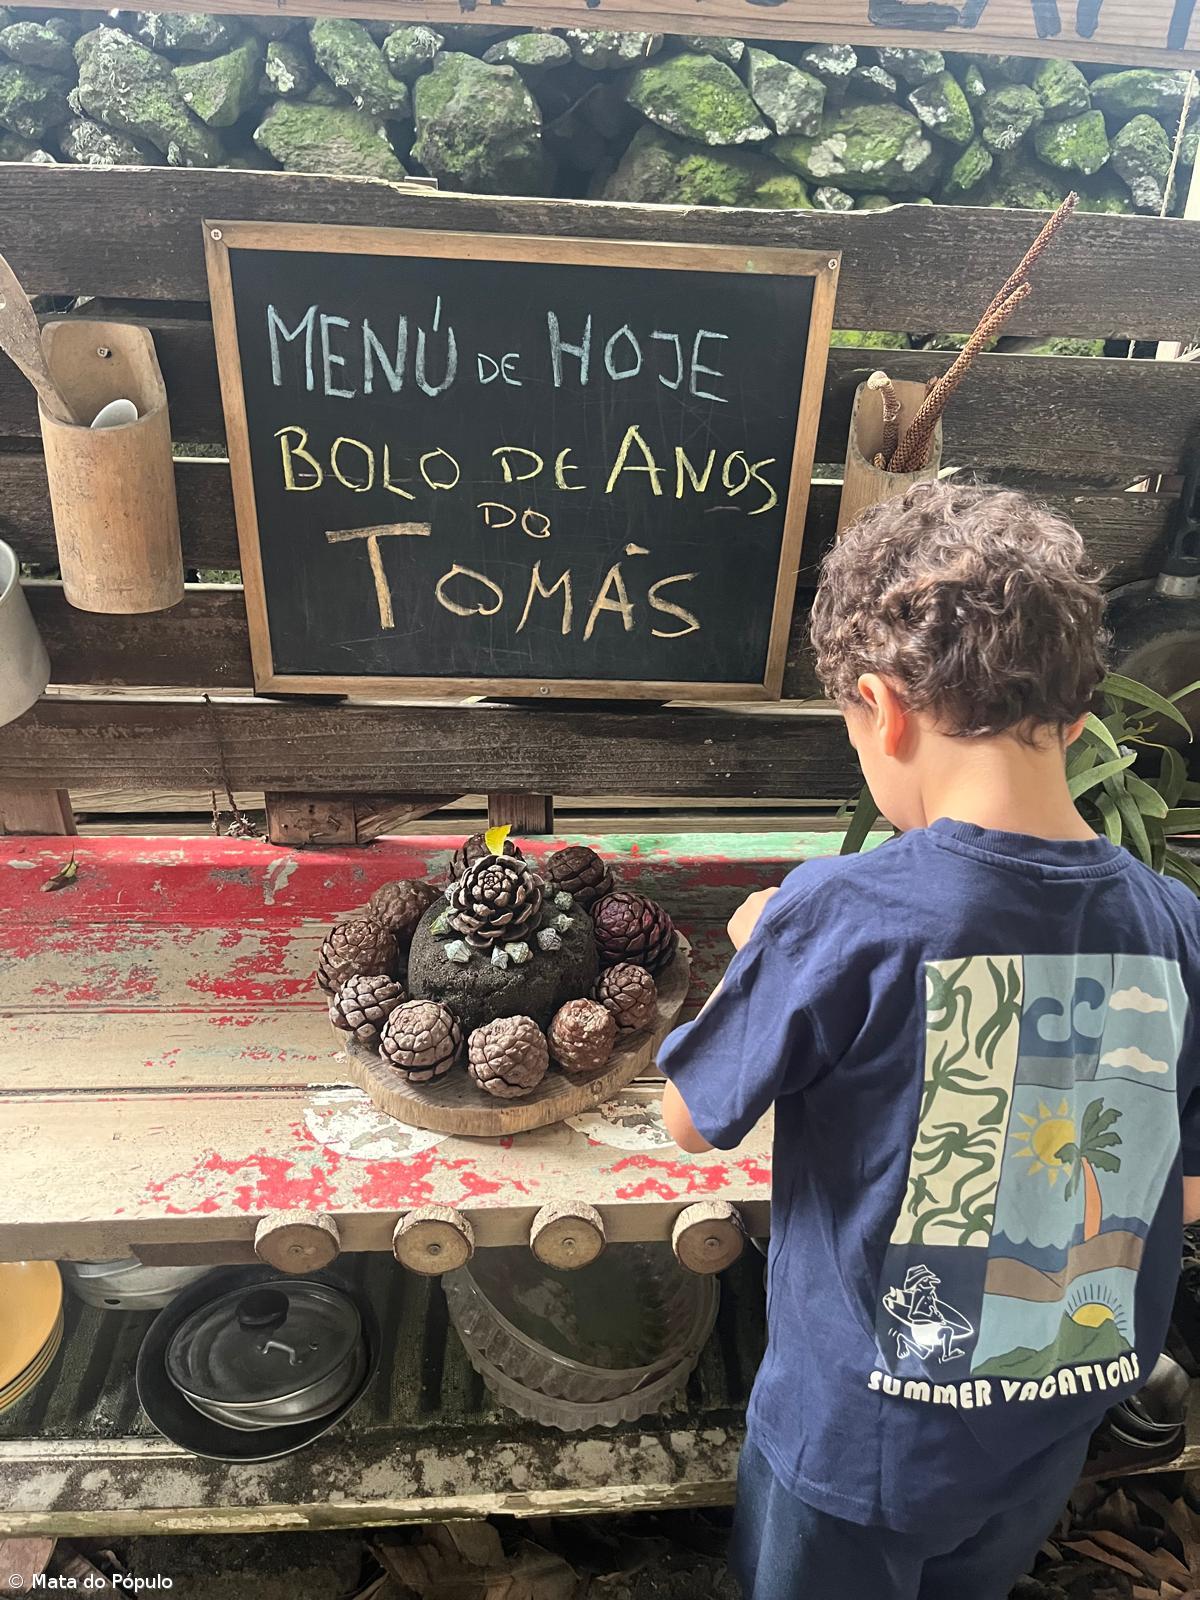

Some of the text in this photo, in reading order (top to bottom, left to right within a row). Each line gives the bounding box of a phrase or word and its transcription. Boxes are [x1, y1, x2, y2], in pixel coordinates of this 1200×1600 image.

[266, 296, 730, 402] MENÚ DE HOJE
[274, 424, 778, 515] BOLO DE ANOS
[477, 502, 551, 539] DO
[325, 522, 701, 642] TOMÁS
[867, 1352, 1140, 1410] SUMMER VACATIONS
